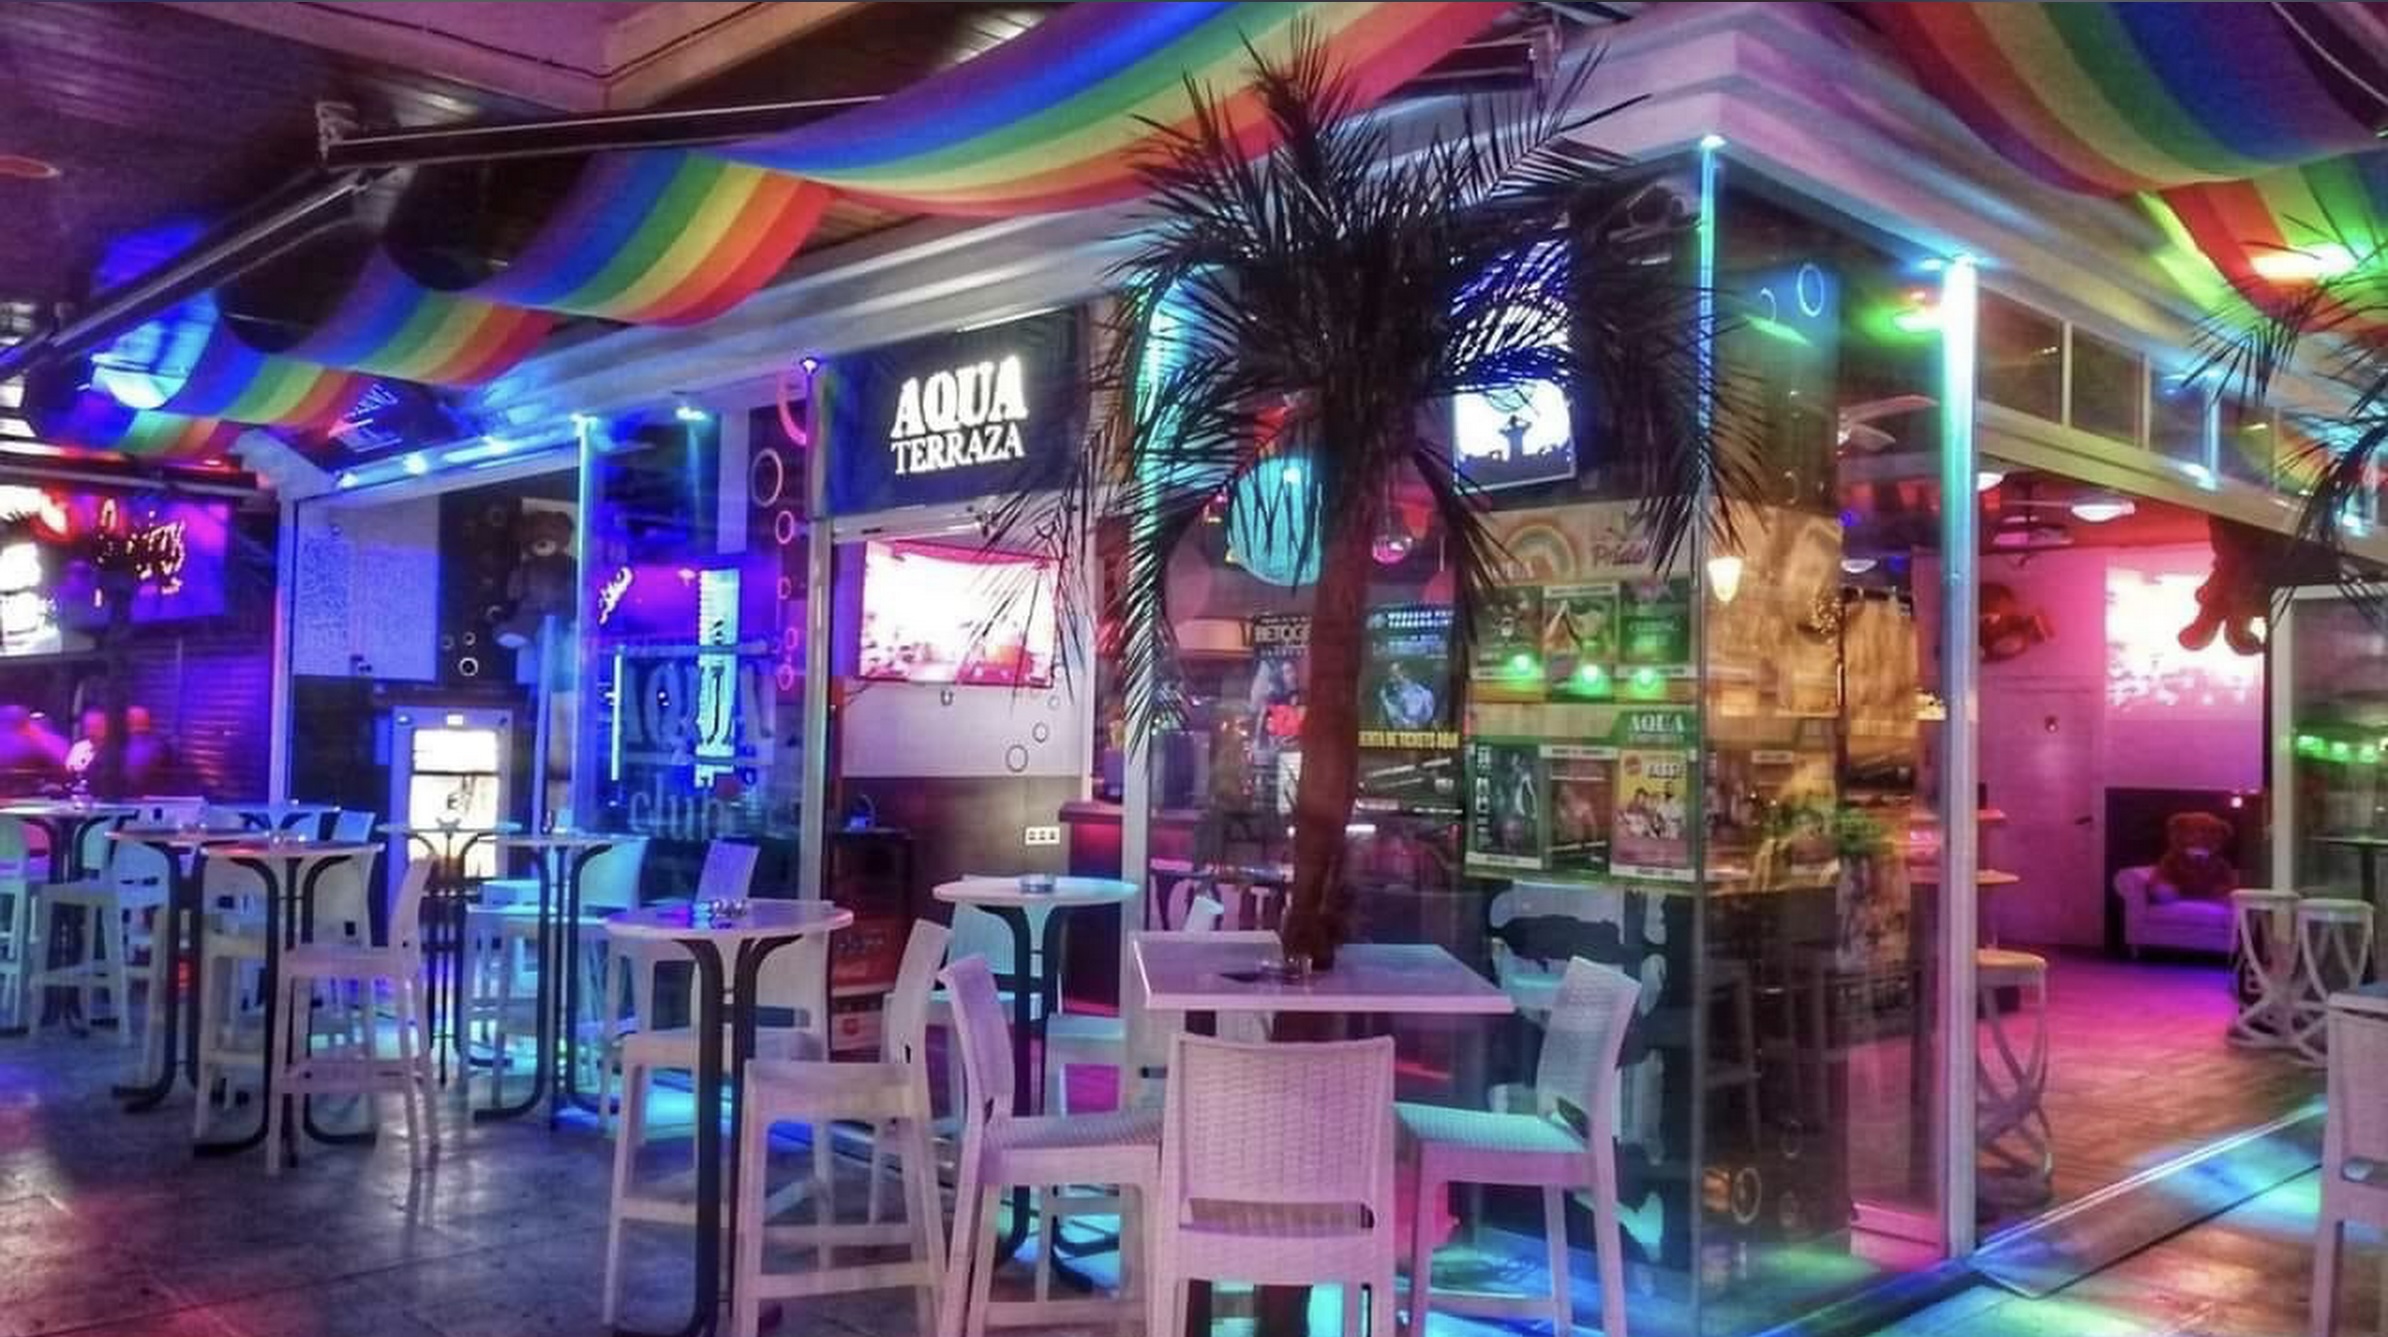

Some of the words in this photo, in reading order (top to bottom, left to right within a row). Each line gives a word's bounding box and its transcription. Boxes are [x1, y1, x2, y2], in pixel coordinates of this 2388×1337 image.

[890, 355, 1029, 438] AQUA
[890, 422, 1026, 475] TERRAZA
[1628, 712, 1686, 732] AQUA
